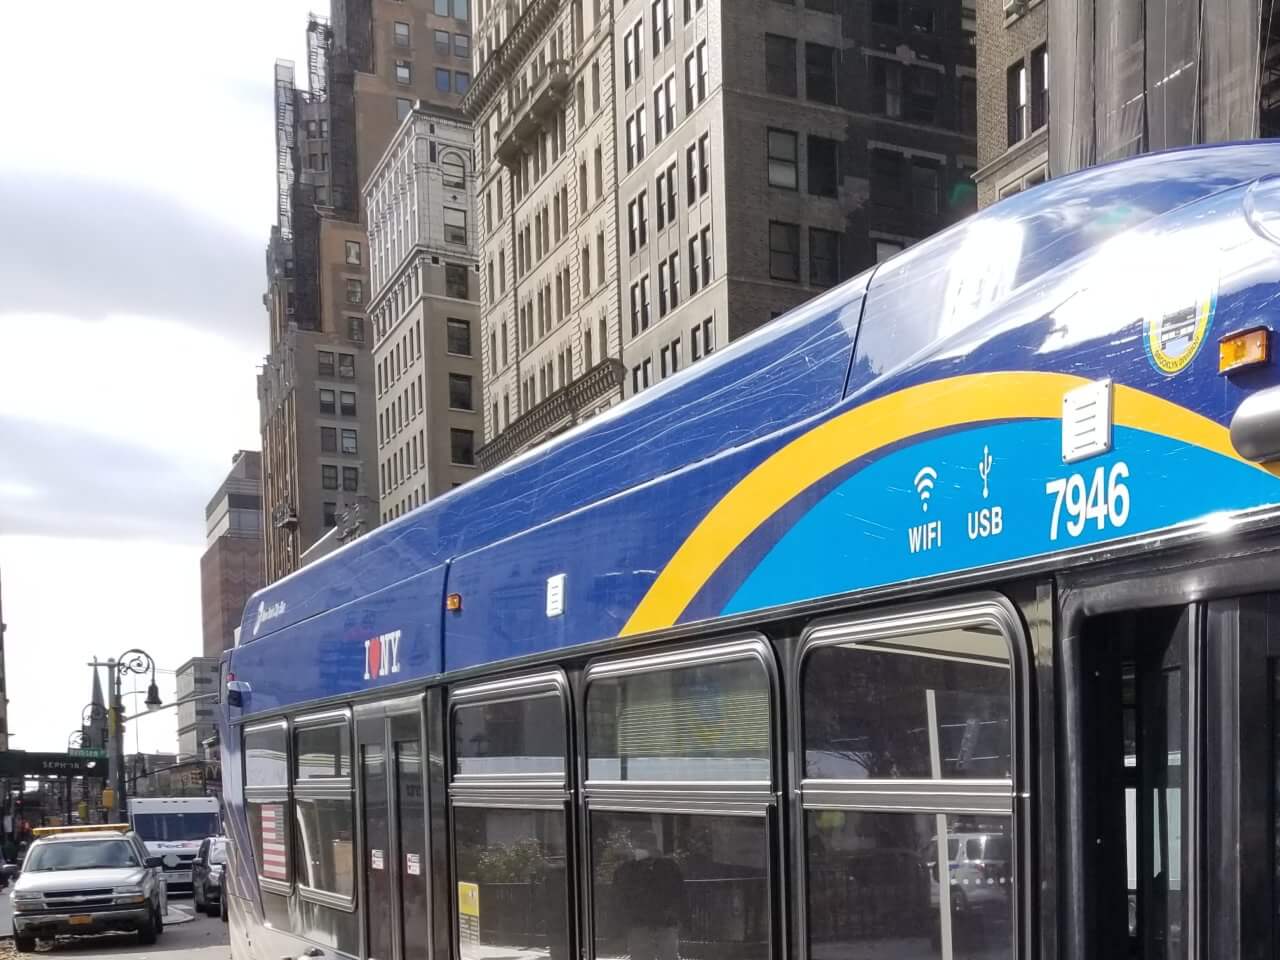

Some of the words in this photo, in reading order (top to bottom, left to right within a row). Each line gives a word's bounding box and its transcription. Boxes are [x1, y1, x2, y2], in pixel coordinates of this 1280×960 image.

[1045, 461, 1130, 541] 7946
[908, 520, 942, 553] WIFI
[967, 506, 1003, 540] USB
